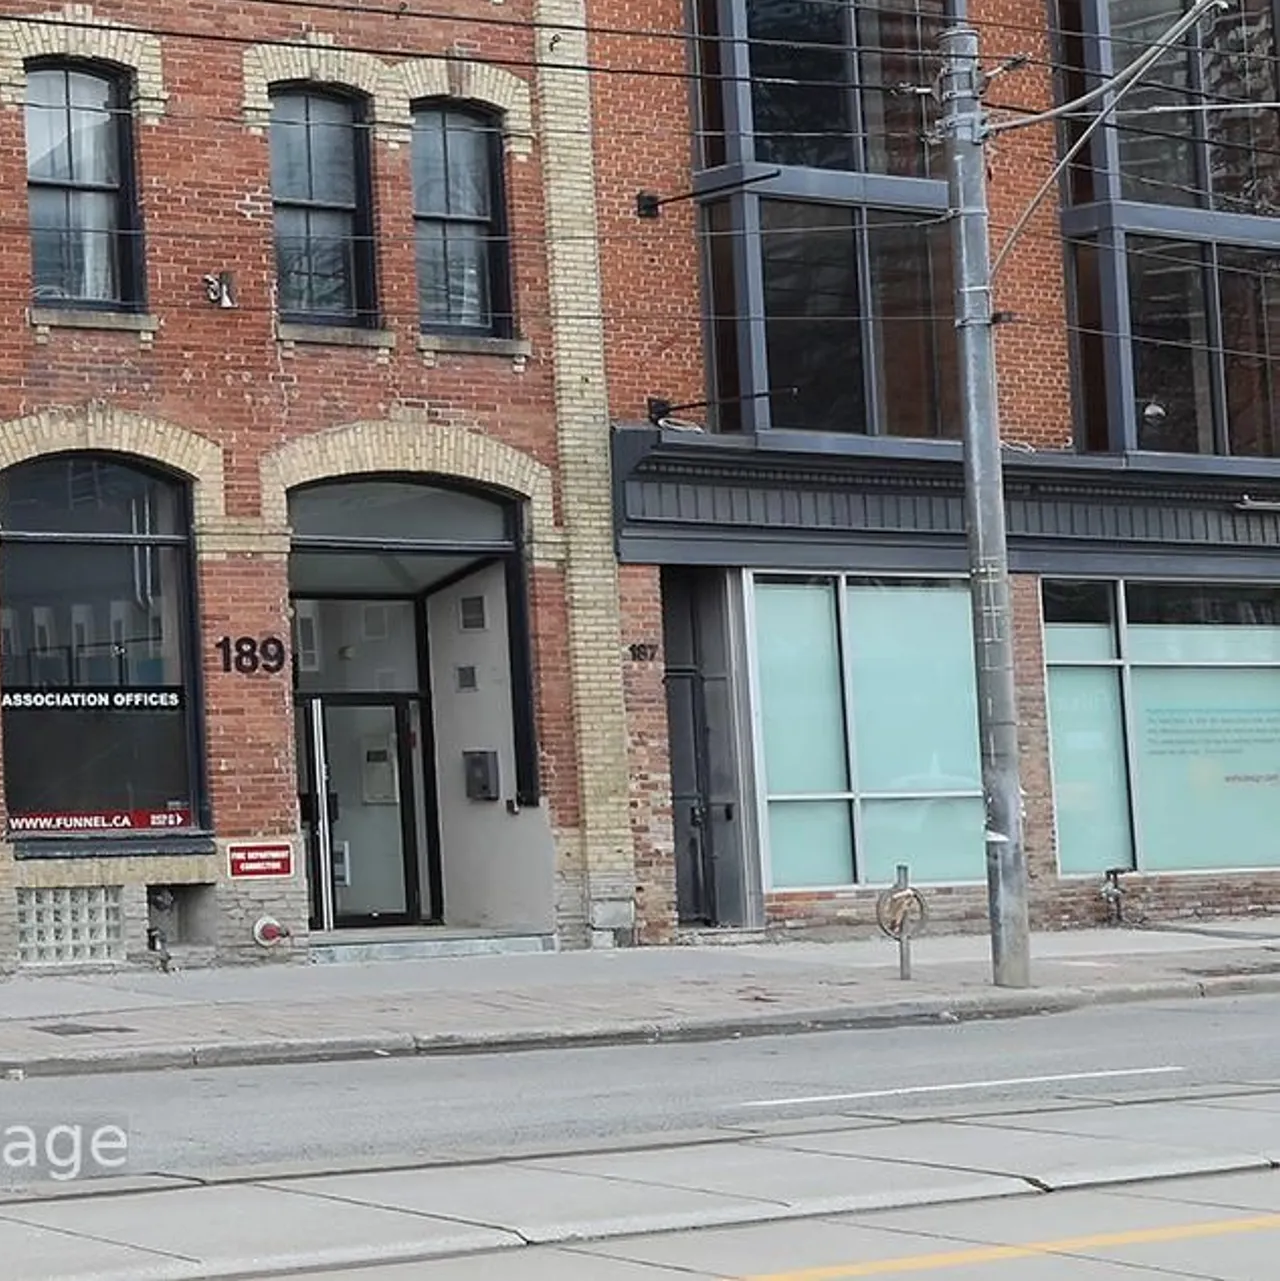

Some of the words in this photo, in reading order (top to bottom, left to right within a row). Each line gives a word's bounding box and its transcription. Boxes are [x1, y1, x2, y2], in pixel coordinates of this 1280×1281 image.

[215, 636, 285, 674] 189
[1, 693, 109, 707] ASSOCIATION
[113, 693, 179, 707] OFFICES
[9, 814, 132, 829] WWW.FUNNEL.CA
